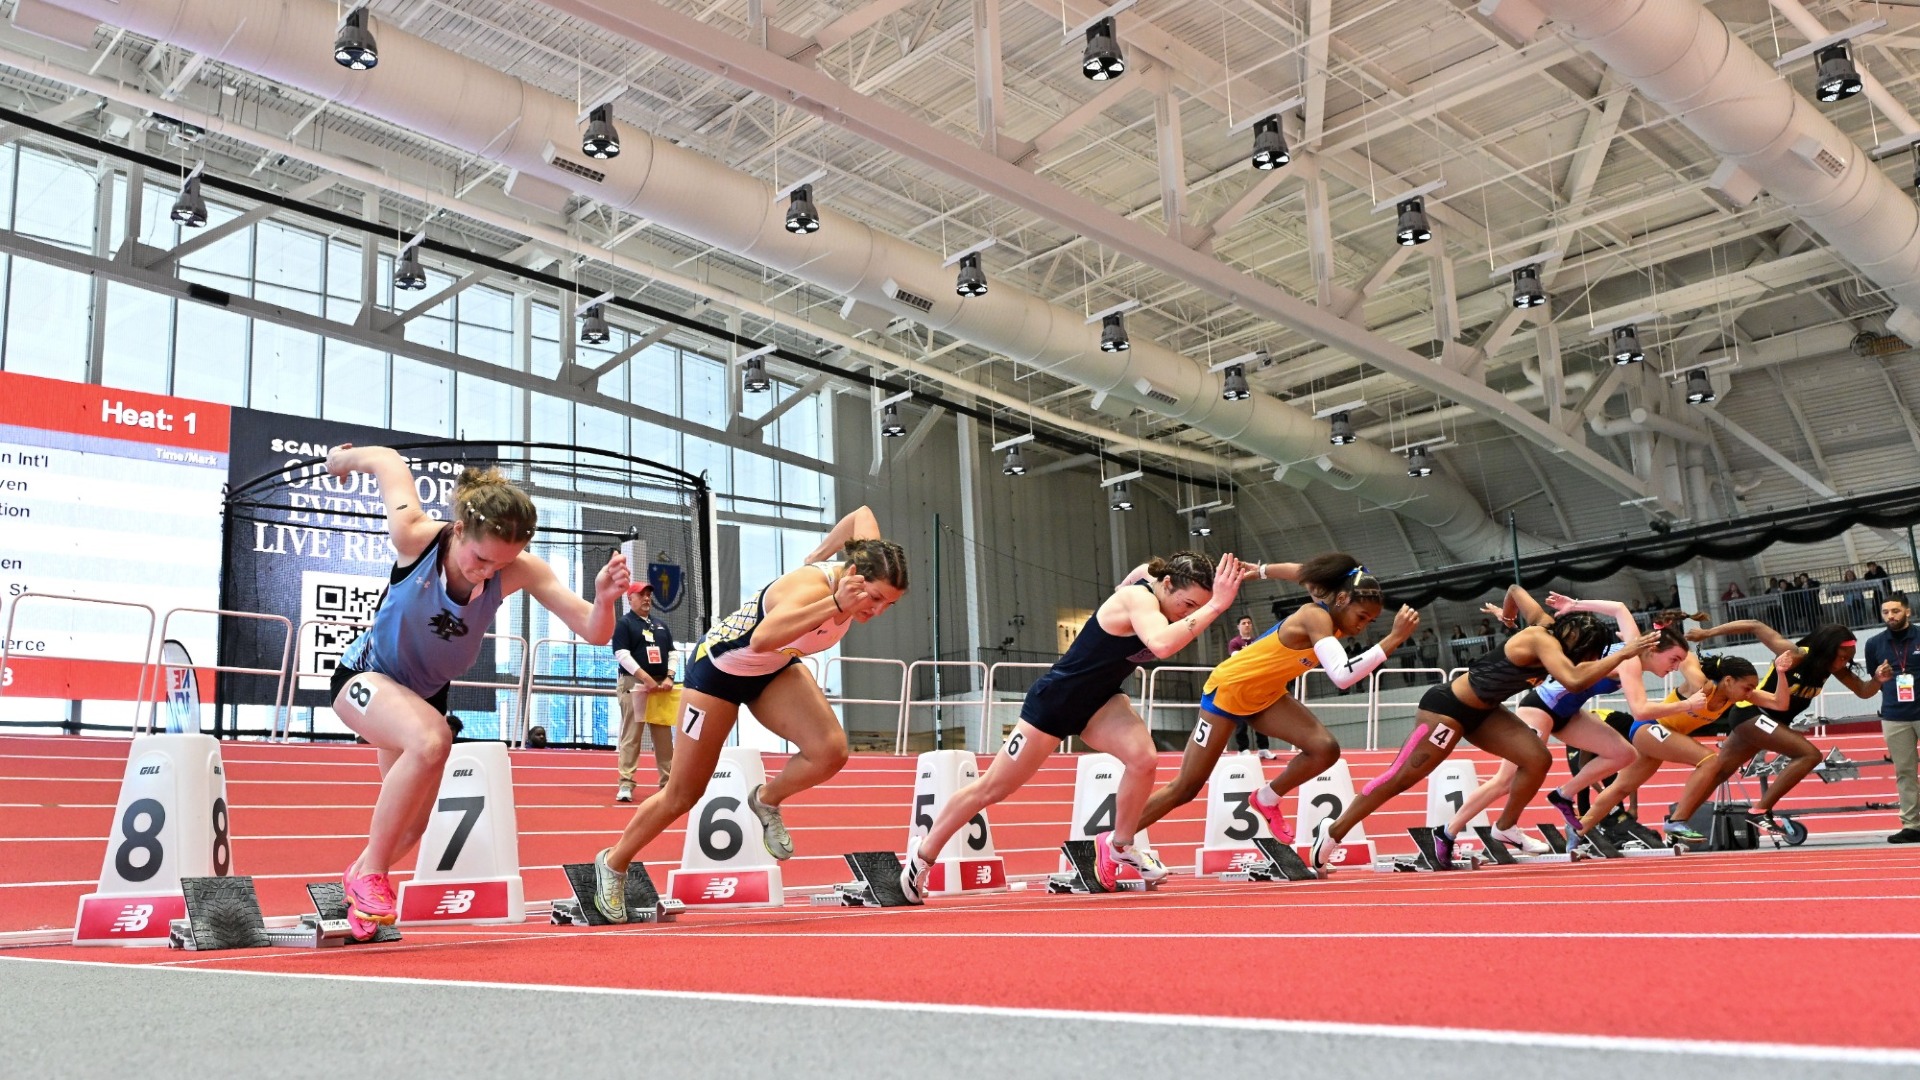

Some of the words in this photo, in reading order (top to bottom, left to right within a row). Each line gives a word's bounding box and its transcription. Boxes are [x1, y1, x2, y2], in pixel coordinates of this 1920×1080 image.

[101, 399, 173, 432] Heat:
[184, 412, 196, 434] 1
[19, 452, 48, 468] Int'l
[155, 447, 217, 466] Time/Mark
[271, 439, 328, 457] SCAN
[428, 461, 465, 475] FOR
[282, 459, 382, 498] ORDE
[414, 476, 455, 506] OF
[253, 521, 330, 558] LIVE
[349, 681, 372, 708] 8
[685, 707, 700, 734] 7
[1196, 721, 1209, 743] 5
[1433, 728, 1450, 746] 4
[1651, 725, 1668, 739] 2
[1760, 718, 1775, 728] 1
[1008, 733, 1023, 756] 6
[140, 765, 161, 775] GILL
[453, 768, 473, 777] GILL
[712, 771, 732, 779] GILL
[698, 796, 743, 861] 6
[915, 794, 935, 834] 5
[1083, 793, 1117, 836] 4
[1223, 792, 1259, 840] 3
[1311, 793, 1343, 838] 2
[1444, 791, 1467, 832] 1
[115, 798, 166, 882] 8
[212, 797, 230, 877] 8
[436, 796, 485, 871] 7
